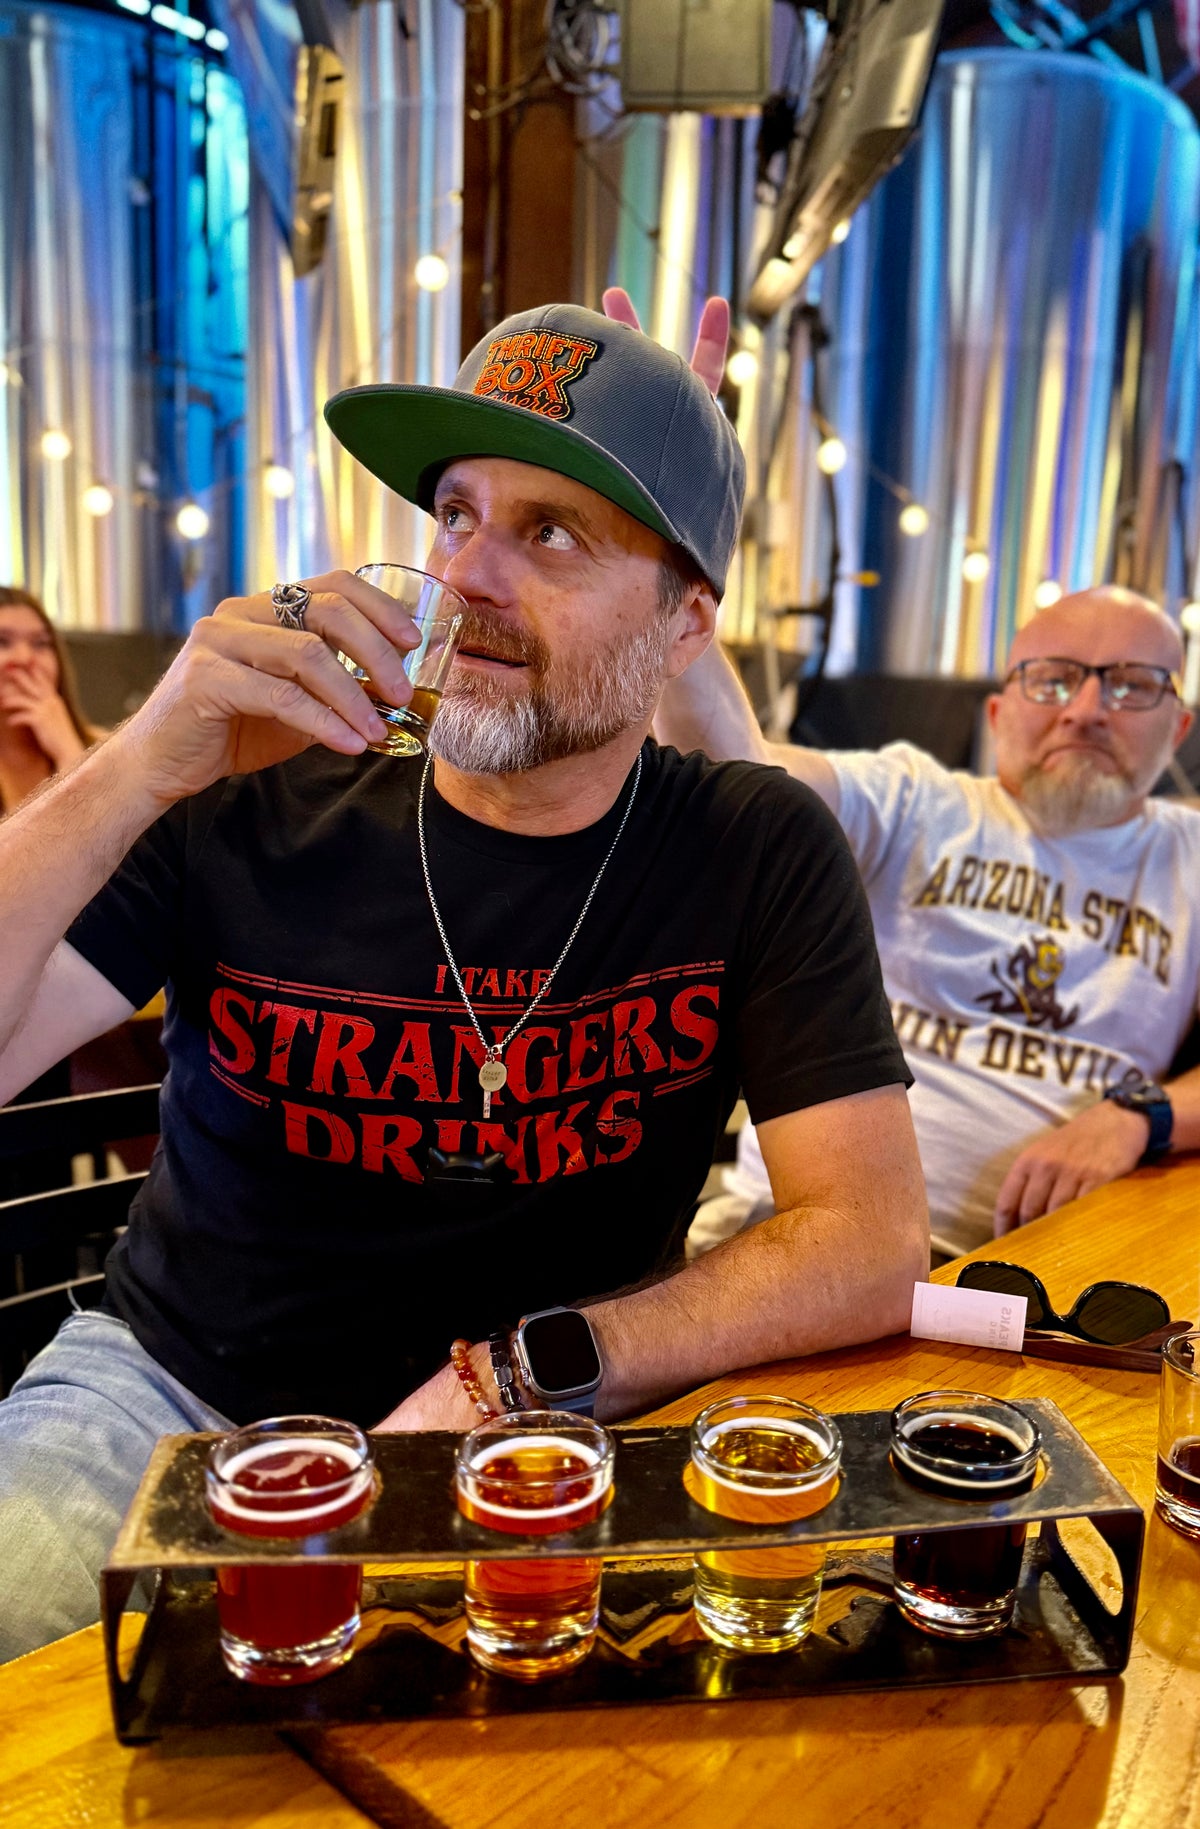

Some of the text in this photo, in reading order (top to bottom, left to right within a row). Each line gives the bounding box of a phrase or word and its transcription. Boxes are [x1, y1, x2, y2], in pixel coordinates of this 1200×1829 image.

[487, 332, 594, 369] THRIFT
[473, 359, 573, 405] BOX
[912, 854, 1173, 986] ARIZONA STATE
[434, 964, 554, 997] I TAKE
[208, 985, 720, 1106] STRANGERS
